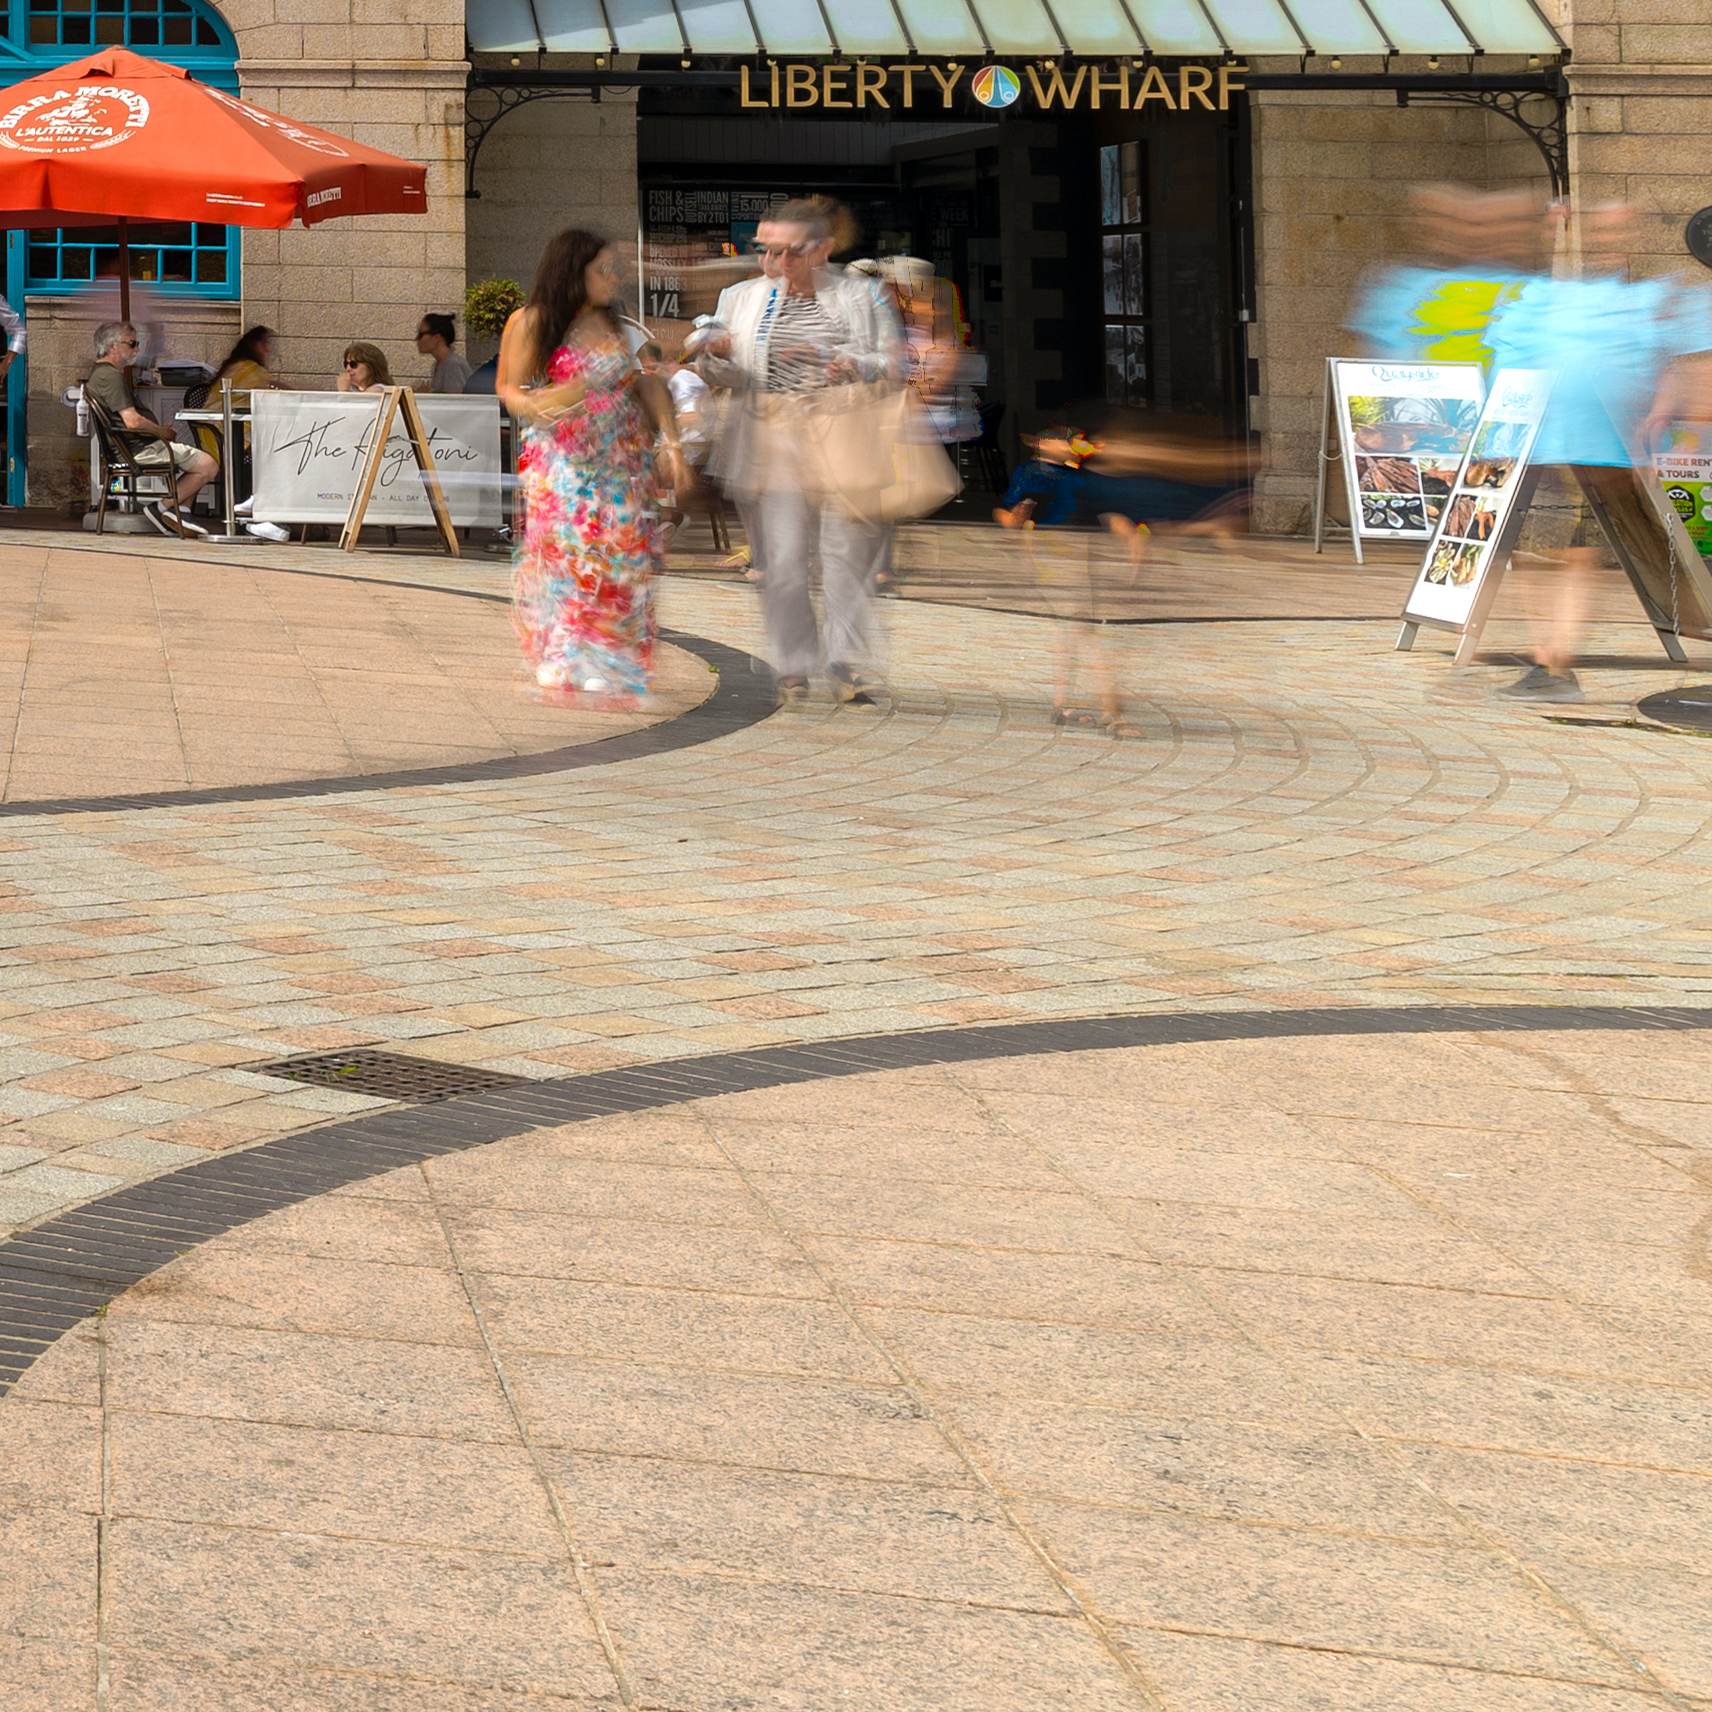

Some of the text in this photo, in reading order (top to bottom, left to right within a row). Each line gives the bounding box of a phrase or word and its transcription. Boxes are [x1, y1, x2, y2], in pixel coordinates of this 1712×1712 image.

[740, 64, 1250, 111] LIBERTY WHARF
[74, 86, 151, 128] MORETTI
[15, 126, 113, 137] L'AUTENTICA
[56, 146, 87, 154] LAGER
[649, 190, 684, 205] FISH &
[697, 191, 729, 204] INDIAN
[649, 206, 684, 223] CHIPS
[697, 211, 707, 223] BY
[708, 211, 714, 223] 2
[714, 212, 725, 223] TO
[650, 276, 661, 291] IN
[650, 293, 680, 318] 1/4
[273, 416, 346, 475] The
[1656, 457, 1689, 467] E-BIKE
[1666, 469, 1700, 478] TOURS
[317, 492, 343, 501] MODERN
[389, 494, 403, 502] ALL
